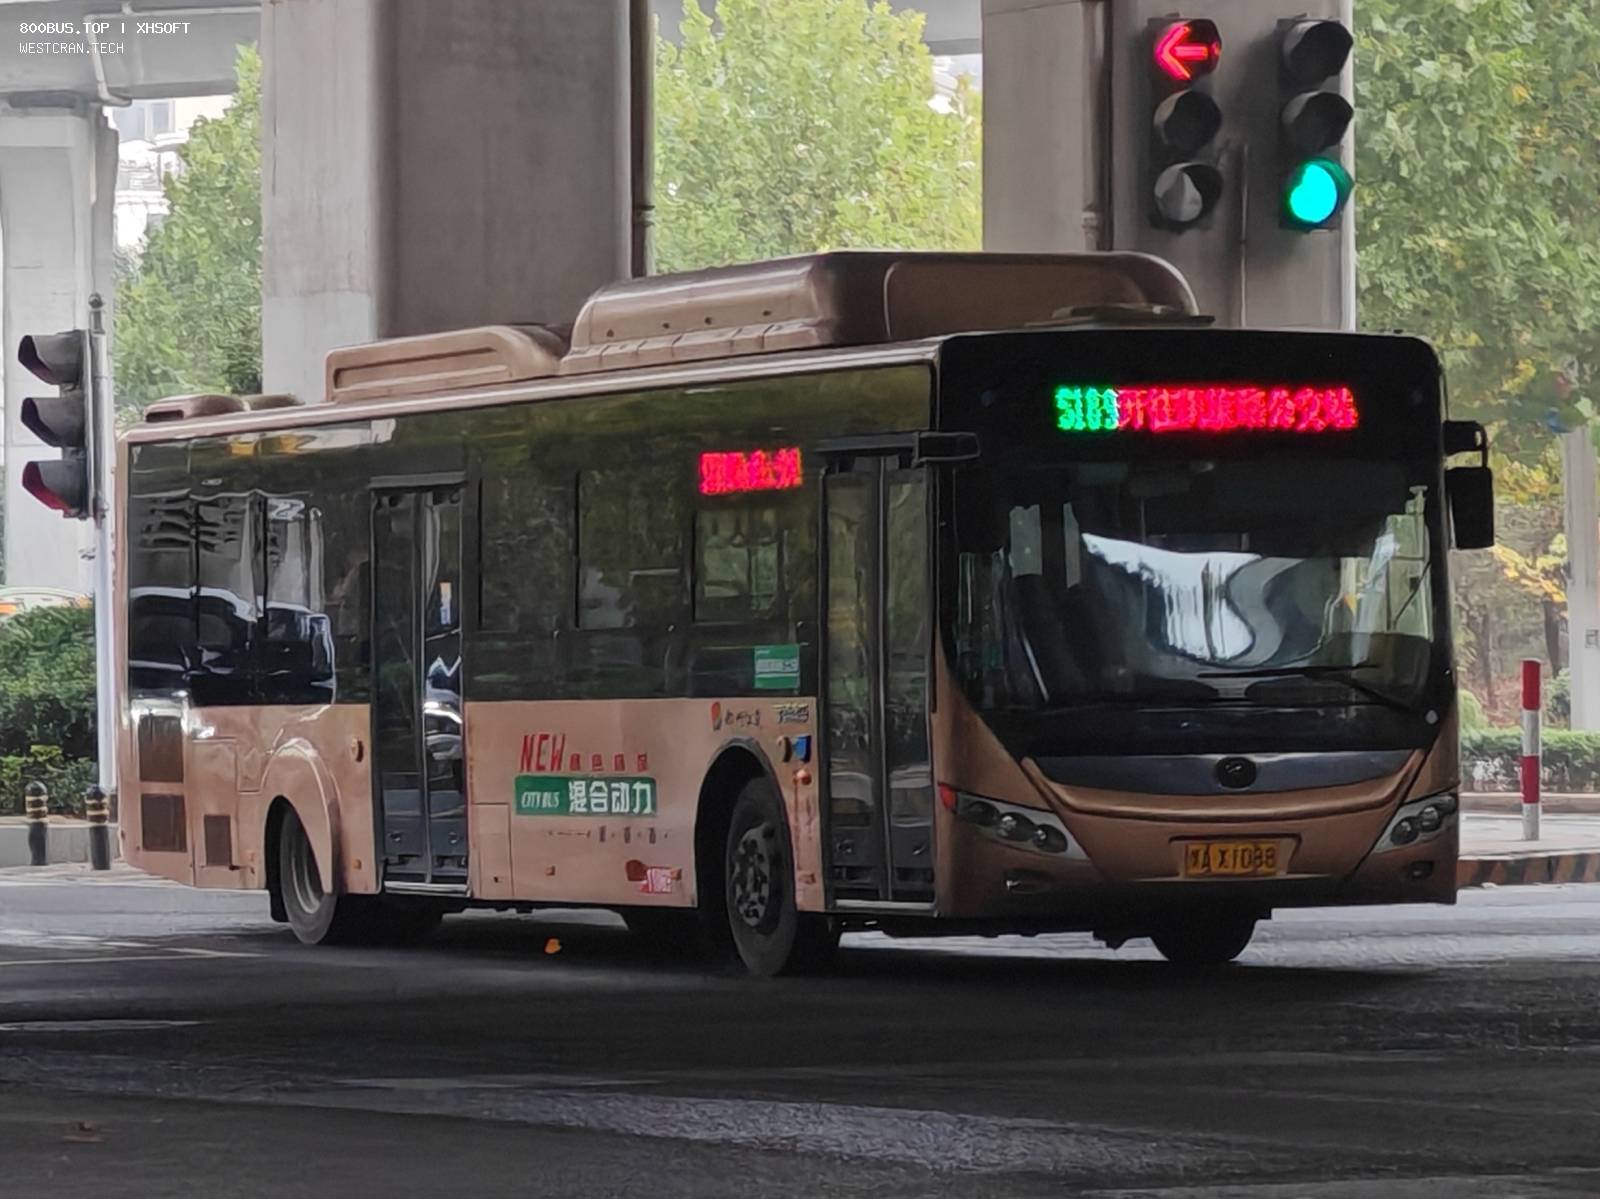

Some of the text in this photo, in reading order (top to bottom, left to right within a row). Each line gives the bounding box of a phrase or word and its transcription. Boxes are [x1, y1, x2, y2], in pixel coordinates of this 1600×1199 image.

[520, 733, 566, 772] NEW
[568, 780, 653, 814] 混合动力
